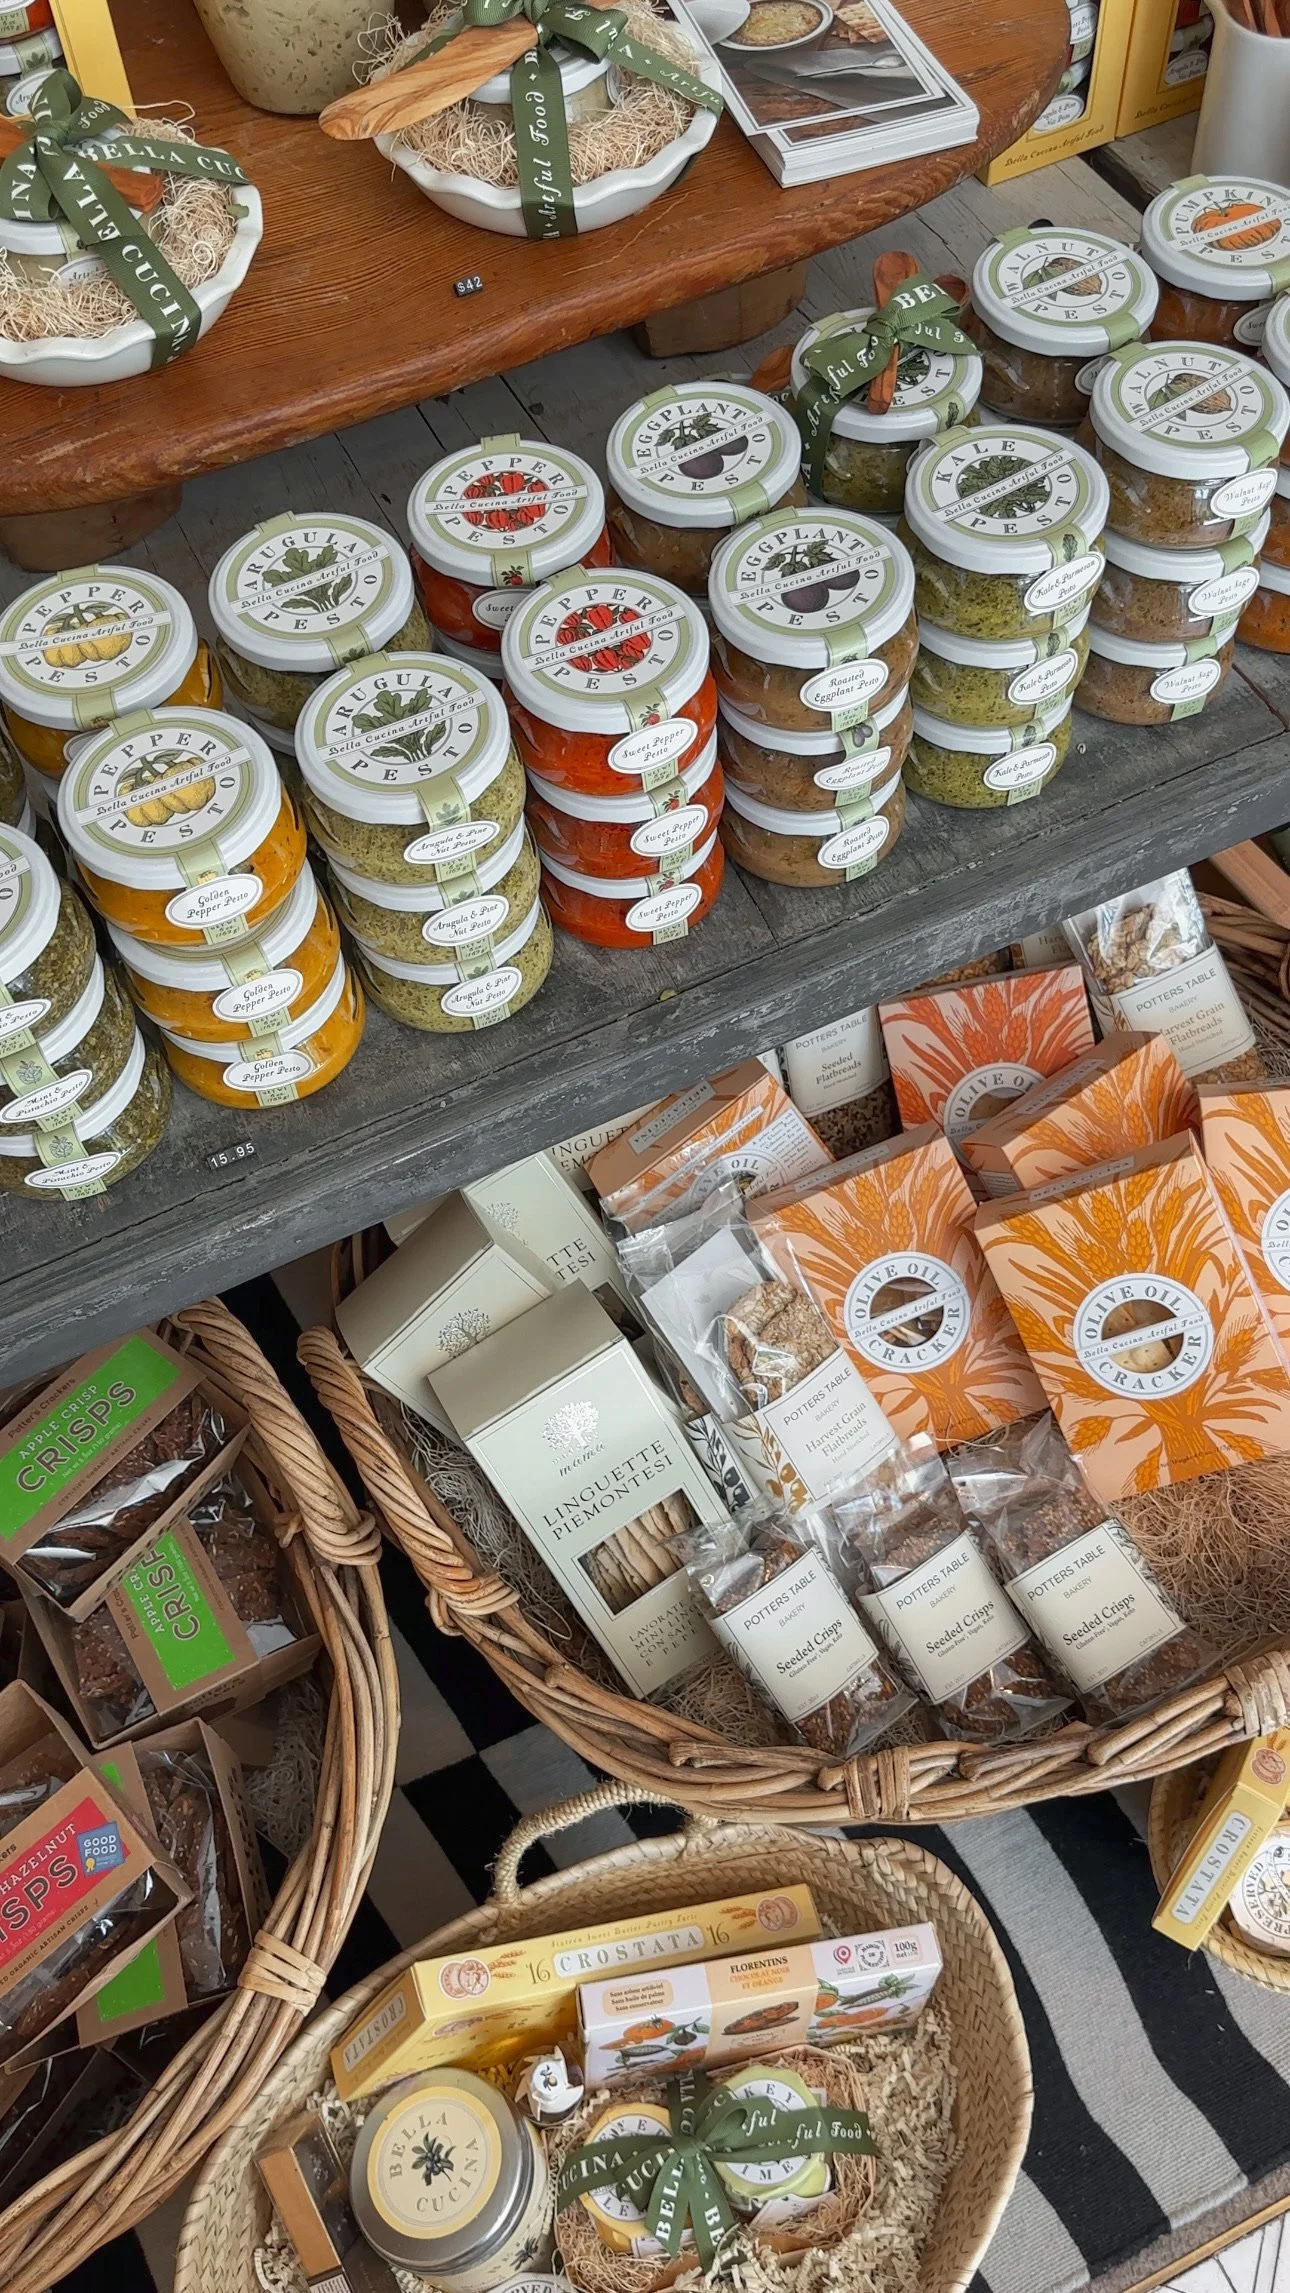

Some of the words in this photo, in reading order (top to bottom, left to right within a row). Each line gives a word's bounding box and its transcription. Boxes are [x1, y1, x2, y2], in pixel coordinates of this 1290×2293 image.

[78, 100, 110, 129] Food
[525, 90, 550, 146] Food
[532, 157, 563, 221] Artful
[1006, 242, 1100, 292] WALNUT
[1032, 271, 1126, 320] PESTO
[1128, 356, 1222, 415] WALNUT
[1139, 411, 1164, 427] Bella
[1164, 396, 1195, 413] Cucina
[1195, 379, 1222, 399] Artful
[1222, 367, 1242, 382] Food
[636, 402, 747, 458] EGGPLANT
[1164, 385, 1257, 441] PESTO
[443, 457, 565, 496] PEPPER
[658, 433, 766, 492] PESTO
[935, 440, 1016, 483] KALE
[944, 502, 972, 517] Bella
[973, 484, 1007, 504] Cucina
[1009, 467, 1039, 487] Artful
[1040, 455, 1064, 471] Food
[444, 504, 569, 546] PESTO
[969, 473, 1072, 534] PESTO
[244, 531, 358, 591] ARUGULA
[740, 587, 771, 601] Bella
[774, 573, 813, 591] Cucina
[815, 561, 852, 580] Artful
[855, 550, 882, 565] Food
[741, 527, 865, 582] EGGPLANT
[22, 585, 145, 634] PEPPER
[262, 574, 378, 630] PESTO
[535, 587, 653, 645] PEPPER
[756, 569, 879, 626] PESTO
[1201, 586, 1232, 601] Walnut
[25, 634, 151, 684] PESTO
[534, 649, 566, 666] Bella
[569, 636, 607, 655] Cucina
[609, 620, 645, 641] Artful
[647, 610, 674, 626] Food
[552, 629, 674, 690] PESTO
[814, 684, 855, 705] Eggplant
[856, 677, 879, 690] Pesto
[828, 669, 865, 687] Roasted
[1018, 680, 1037, 694] Kale
[1044, 657, 1072, 680] Parmesan
[327, 740, 362, 756] Bella
[365, 723, 405, 744] Cucina
[407, 708, 446, 729] Artful
[449, 696, 475, 714] Food
[332, 673, 454, 737] ARUGULA
[93, 732, 217, 796] PEPPER
[351, 722, 473, 782] PESTO
[622, 742, 651, 759] Sweet
[652, 728, 686, 747] Pepper
[643, 746, 669, 762] Pesto
[96, 800, 127, 816] Bella
[130, 784, 167, 804] Cucina
[169, 769, 204, 789] Artful
[206, 756, 232, 773] Food
[109, 776, 236, 843] PESTO
[643, 829, 671, 844] Sweet
[672, 814, 700, 834] Pepper
[663, 833, 687, 847] Pesto
[831, 842, 865, 863] Eggplant
[866, 830, 884, 845] Pesto
[842, 827, 871, 848] Roasted
[186, 901, 222, 919] Pepper
[224, 890, 249, 906] Pesto
[198, 888, 230, 908] Golden
[433, 914, 469, 932] Arugula
[479, 903, 499, 916] Pine
[448, 926, 469, 939] Nut
[469, 919, 492, 932] Pesto
[232, 995, 266, 1014] Pepper
[267, 984, 292, 1000] Pesto
[243, 982, 274, 1001] Golden
[1136, 985, 1185, 1012] POTTERS
[1185, 967, 1217, 990] TABLE
[1195, 1001, 1226, 1022] Grain
[795, 1027, 838, 1050] POTTERS
[840, 1013, 868, 1033] TABLE
[1169, 1017, 1223, 1045] Flatbreads
[815, 1060, 862, 1084] Flatbreads
[821, 1052, 854, 1072] Seeded
[954, 1072, 1004, 1118] OLIVE
[210, 1142, 256, 1168] 15.95
[855, 1262, 899, 1320] OLIVE
[906, 1262, 940, 1286] OIL
[1085, 1285, 1134, 1340] OLIVE
[1144, 1285, 1182, 1312] OIL
[868, 1306, 960, 1365] CRACKER
[1098, 1334, 1202, 1390] CRACKER
[7, 1410, 42, 1439] Potter's
[39, 1378, 76, 1410] Crackers
[18, 1420, 60, 1460] APPLE
[60, 1385, 98, 1419] CRISP
[782, 1390, 826, 1426] POTTERS
[824, 1367, 852, 1396] TABLE
[16, 1380, 137, 1493] CRISPS
[805, 1417, 843, 1454] Harvest
[840, 1401, 867, 1425] Grain
[821, 1417, 868, 1458] Flatbreads
[543, 1440, 665, 1527] LINGUETTE
[552, 1454, 673, 1540] PIEMONTESI
[895, 1575, 941, 1609] POTTERS
[940, 1552, 970, 1579] TABLE
[928, 1584, 957, 1608] BAKERY
[1026, 1565, 1075, 1601] POTTERS
[1073, 1544, 1106, 1570] TABLE
[1063, 1576, 1092, 1599] BAKERY
[139, 1594, 166, 1633] APPLE
[743, 1594, 790, 1631] POTTERS
[790, 1570, 817, 1596] TABLE
[778, 1602, 807, 1628] BAKERY
[926, 1622, 965, 1654] Seeded
[962, 1600, 995, 1628] Crisps
[1062, 1613, 1103, 1647] Seeded
[1100, 1592, 1136, 1620] Crisps
[775, 1640, 815, 1675] Seeded
[813, 1618, 843, 1648] Crisps
[0, 1823, 77, 1895] HAZELNUT
[83, 1834, 117, 1848] GOOD
[84, 1844, 117, 1858] FOOD
[1174, 1816, 1247, 1917] CROSTATA
[9, 1950, 39, 1977] ORGANIC
[39, 1926, 67, 1950] ARTISAN
[526, 1958, 551, 1985] 16
[560, 1931, 699, 1973] CROSTATA
[706, 1921, 730, 1946] 16
[730, 1955, 789, 1974] FLORENTINS
[894, 1940, 918, 1953] 100g
[344, 1994, 406, 2067] CROSTATA
[389, 2111, 448, 2180] BELLA
[830, 2120, 863, 2139] Food
[416, 2137, 480, 2213] CUCINA
